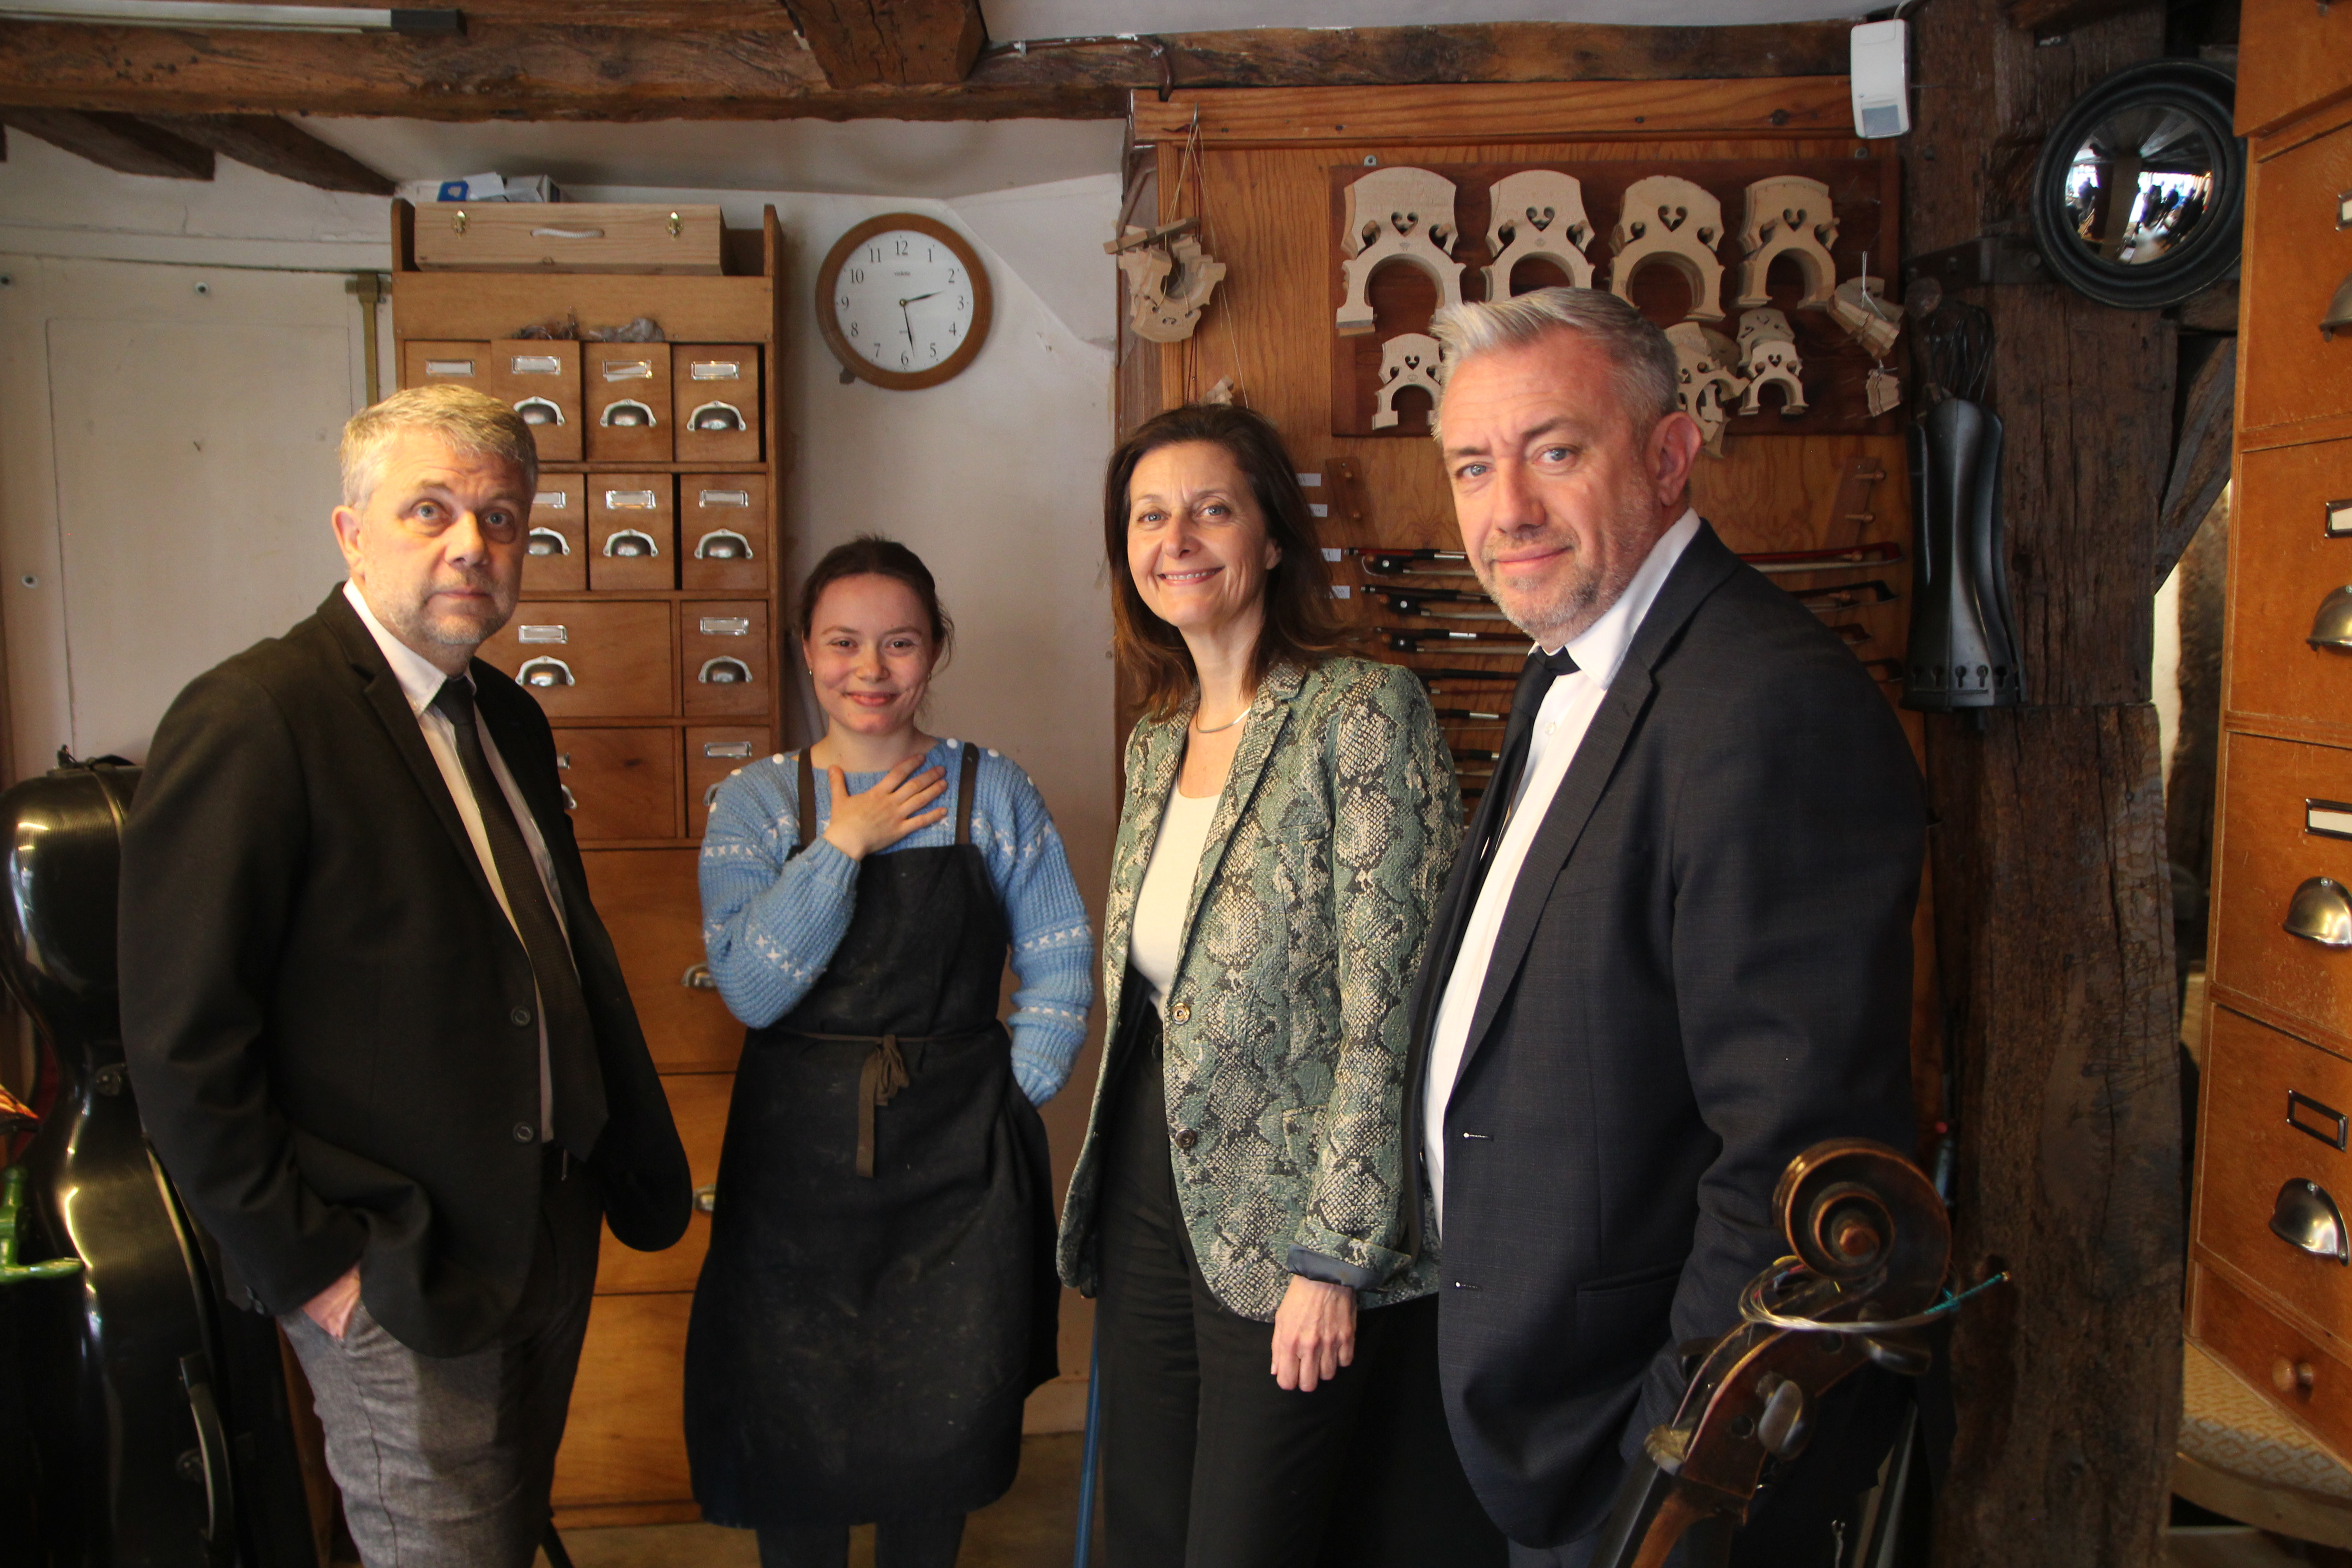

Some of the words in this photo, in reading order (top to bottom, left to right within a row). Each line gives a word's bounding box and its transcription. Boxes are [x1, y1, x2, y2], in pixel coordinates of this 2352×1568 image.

[896, 240, 908, 255] 12
[928, 248, 932, 262] 1
[870, 248, 881, 263] 11
[851, 269, 864, 284] 10
[948, 268, 955, 283] 2
[841, 296, 849, 311] 9
[957, 295, 964, 310] 3
[851, 322, 858, 337] 8
[949, 322, 956, 337] 4
[873, 343, 881, 358] 7
[901, 350, 908, 365] 6
[930, 342, 936, 358] 5
